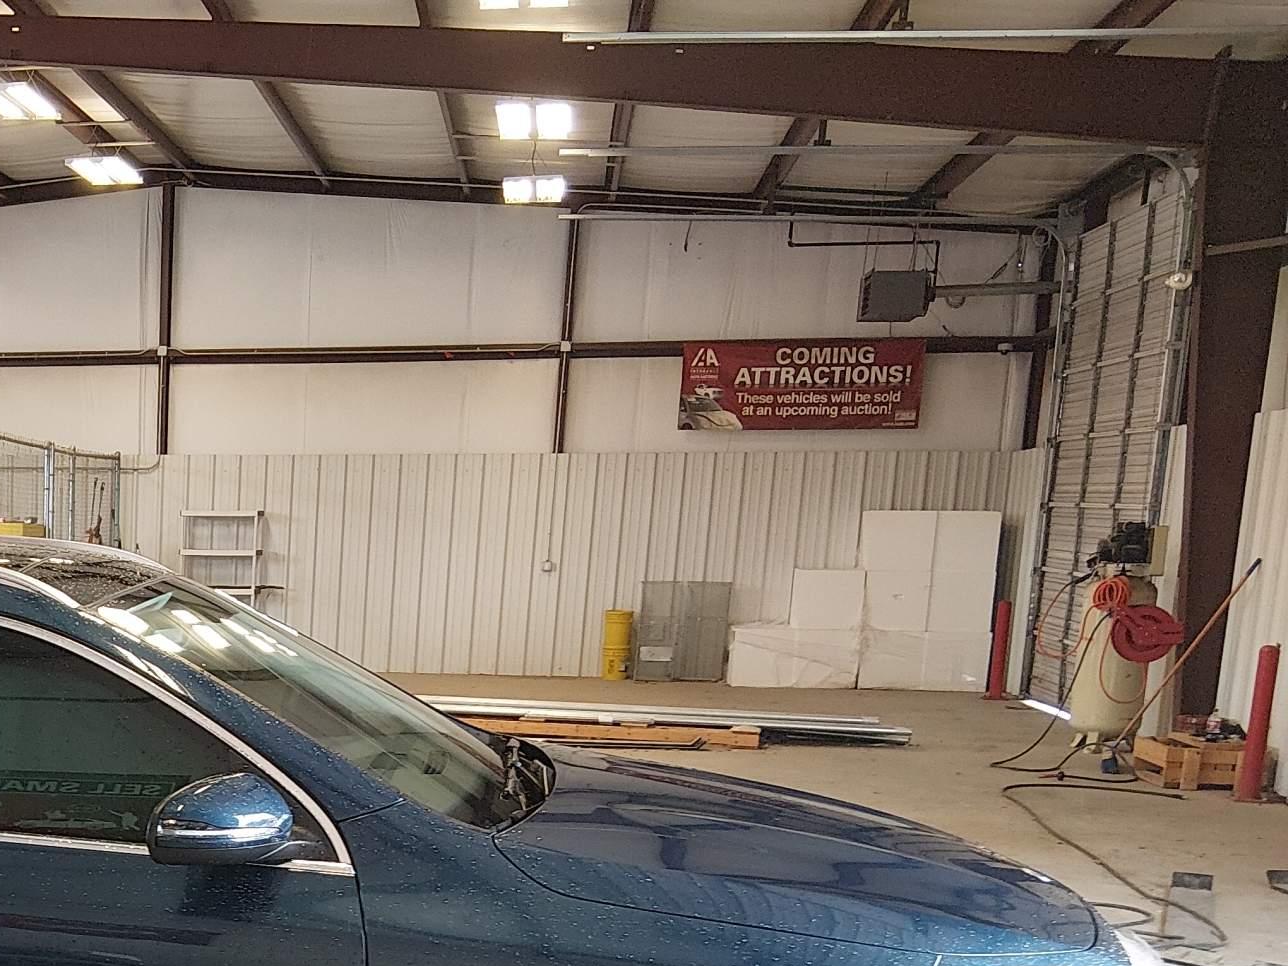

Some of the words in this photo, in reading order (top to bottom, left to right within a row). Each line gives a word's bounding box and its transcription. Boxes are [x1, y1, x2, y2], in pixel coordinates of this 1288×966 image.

[775, 346, 875, 365] COMING
[733, 365, 912, 385] ATTRACTIONS!
[735, 392, 774, 404] These
[776, 391, 828, 404] vehicles
[830, 391, 852, 403] will
[854, 391, 871, 403] be
[873, 390, 902, 403] sold
[741, 405, 754, 416] at
[756, 406, 772, 416] an
[775, 404, 838, 418] upcoming
[840, 402, 892, 415] auction!
